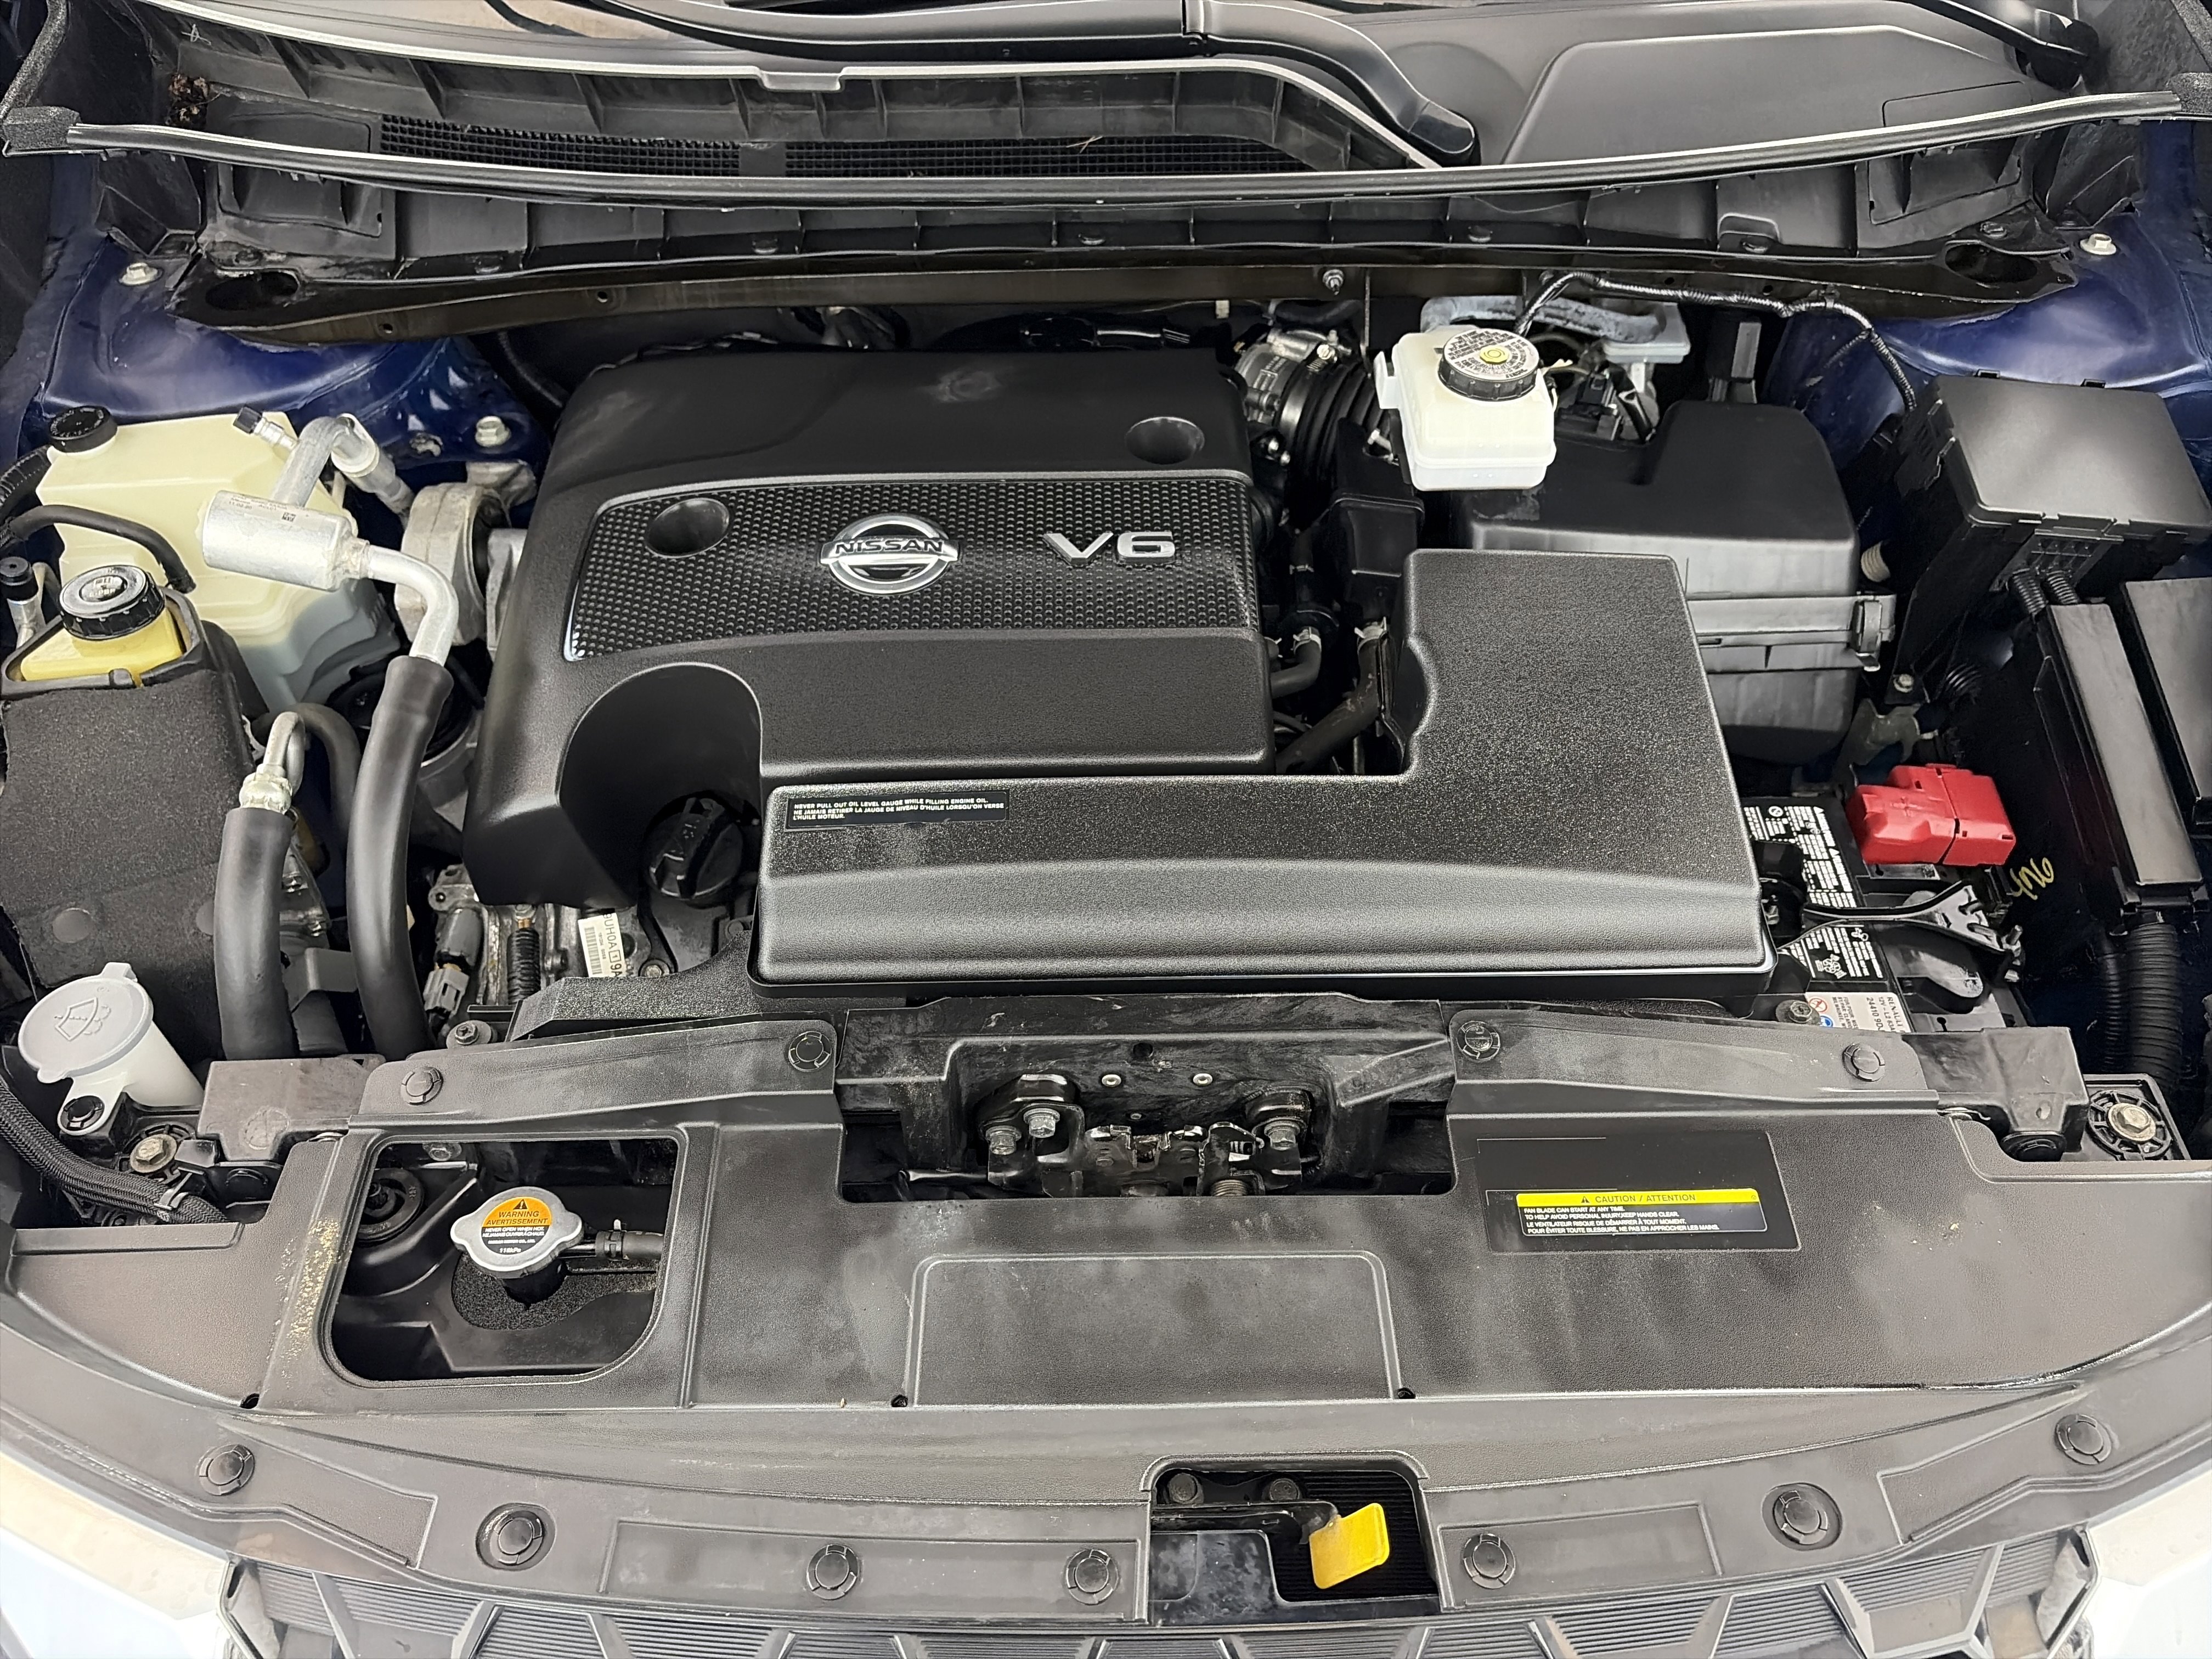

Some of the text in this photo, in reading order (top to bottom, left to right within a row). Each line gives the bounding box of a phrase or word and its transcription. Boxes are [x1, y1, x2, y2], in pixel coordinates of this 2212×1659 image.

[835, 537, 943, 554] NISSAN
[1043, 531, 1175, 565] V6
[1866, 997, 1879, 1017] 24410
